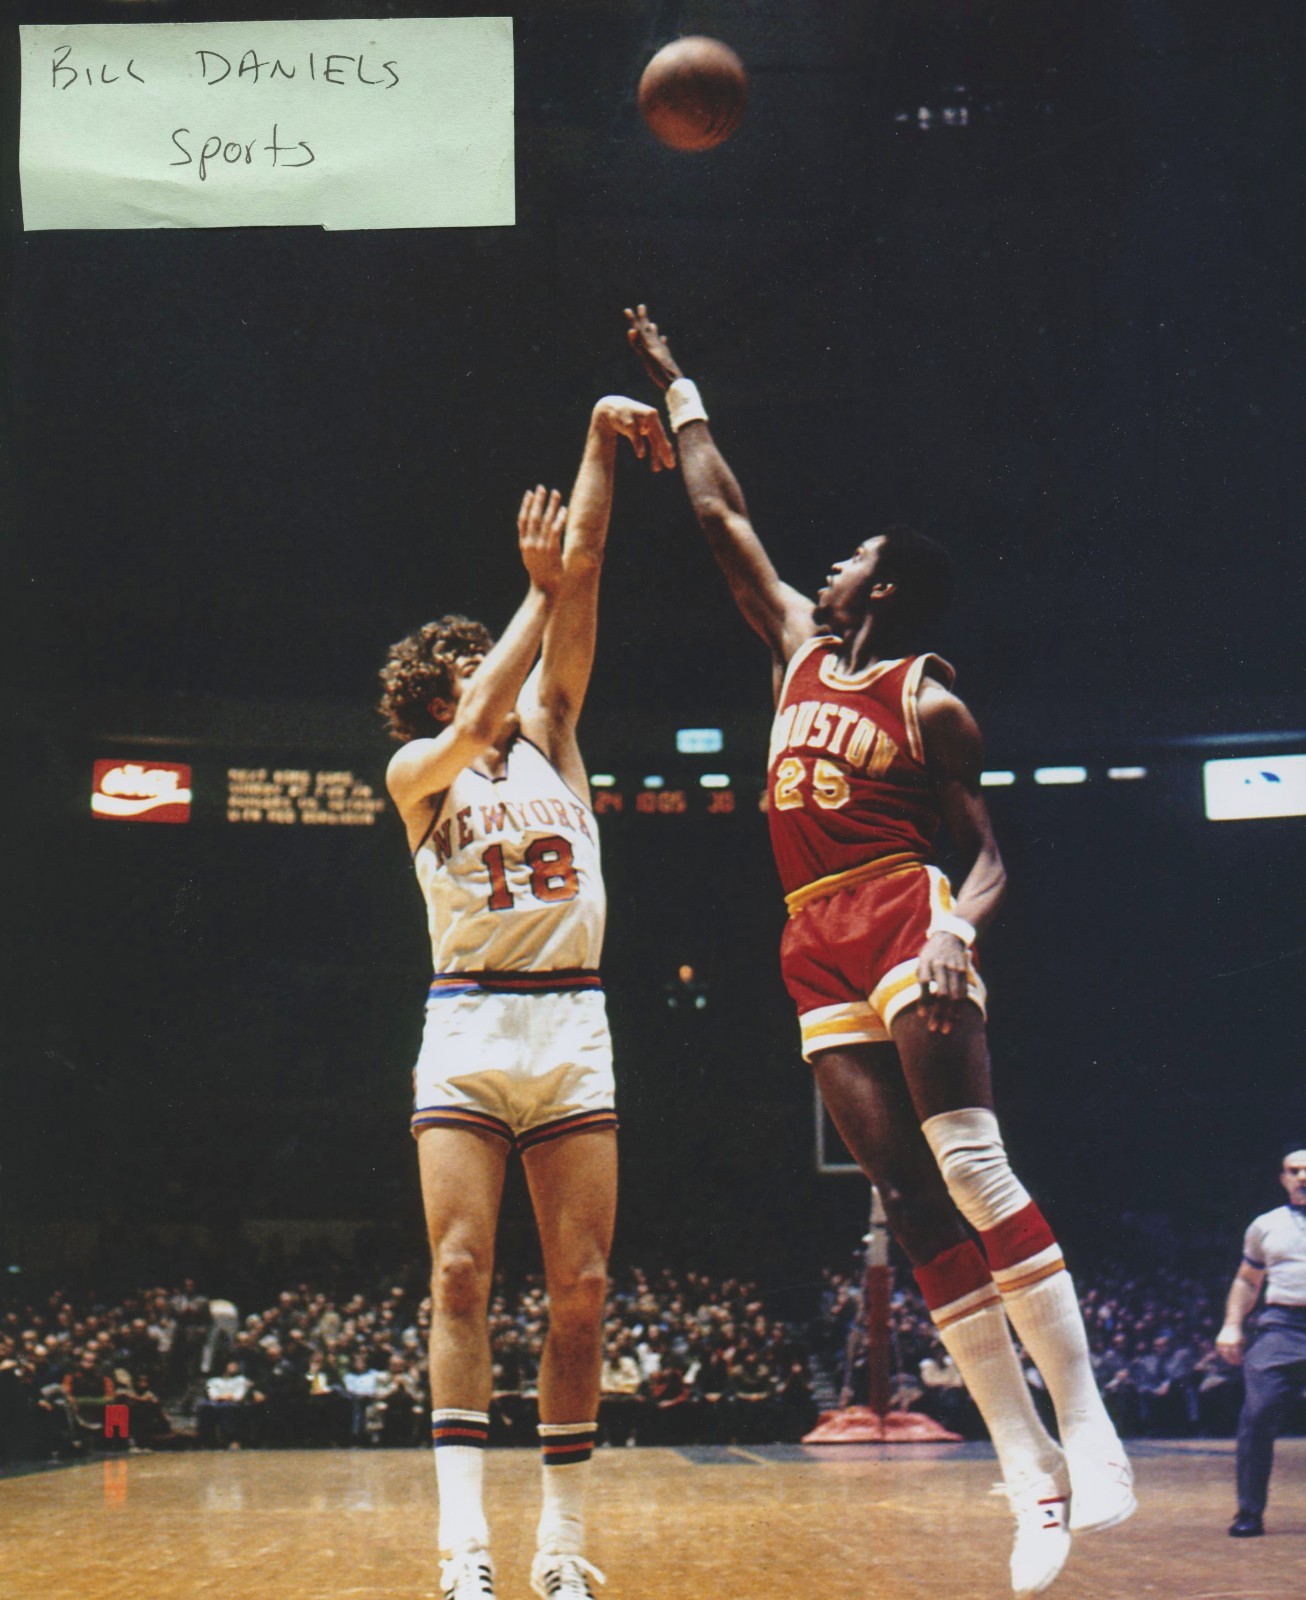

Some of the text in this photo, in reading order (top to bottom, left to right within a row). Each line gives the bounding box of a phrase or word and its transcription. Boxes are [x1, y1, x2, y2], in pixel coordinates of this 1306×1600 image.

[51, 45, 401, 90] BILL DANIELS
[774, 757, 851, 812] 25
[432, 802, 507, 871] NEW
[504, 798, 596, 848] YORK
[482, 835, 581, 913] 18
